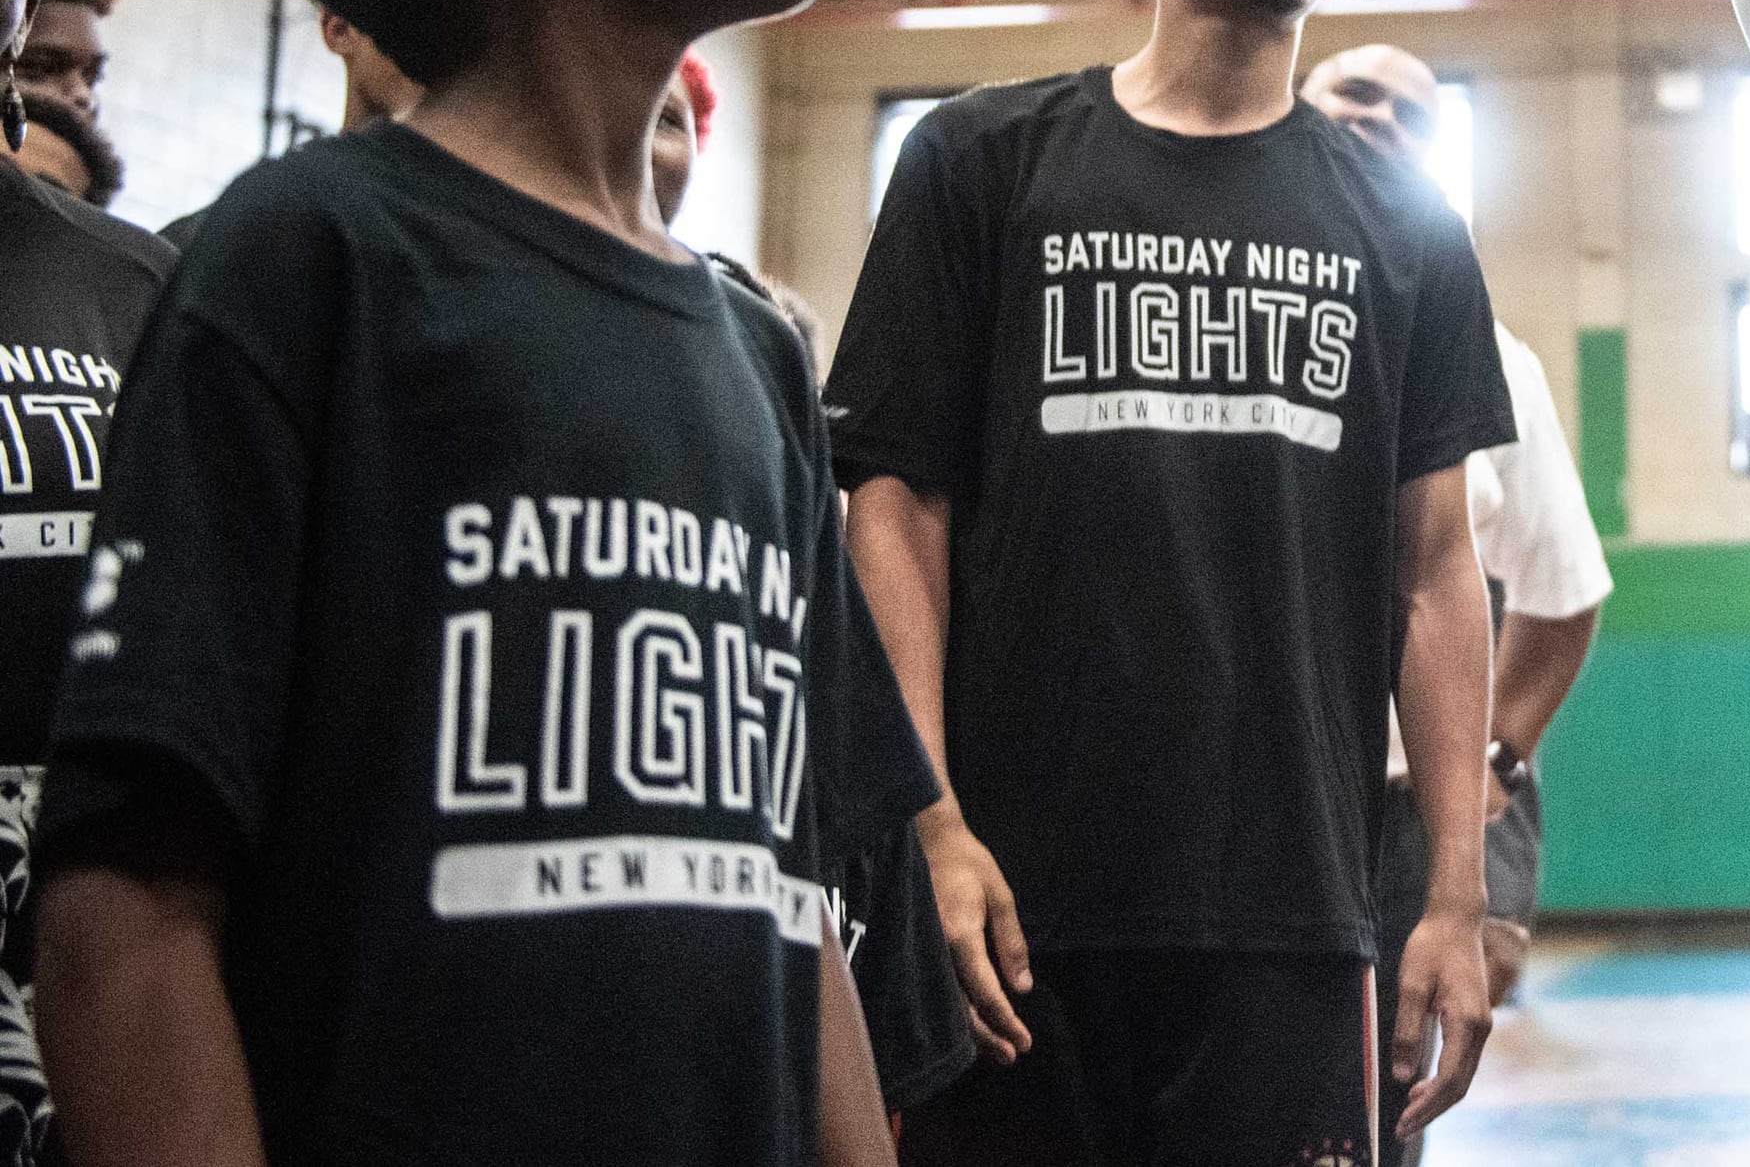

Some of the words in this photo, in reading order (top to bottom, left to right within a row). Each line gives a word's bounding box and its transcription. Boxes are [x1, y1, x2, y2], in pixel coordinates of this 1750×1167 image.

[1044, 231, 1232, 276] SATURDAY
[1247, 241, 1362, 295] NIGHT
[0, 344, 121, 392] NIGH
[1043, 281, 1358, 401] LIGHTS
[1099, 399, 1149, 421] NEW
[1167, 400, 1230, 424] YORK
[435, 608, 806, 841] LIGHT
[537, 851, 647, 897] NEW
